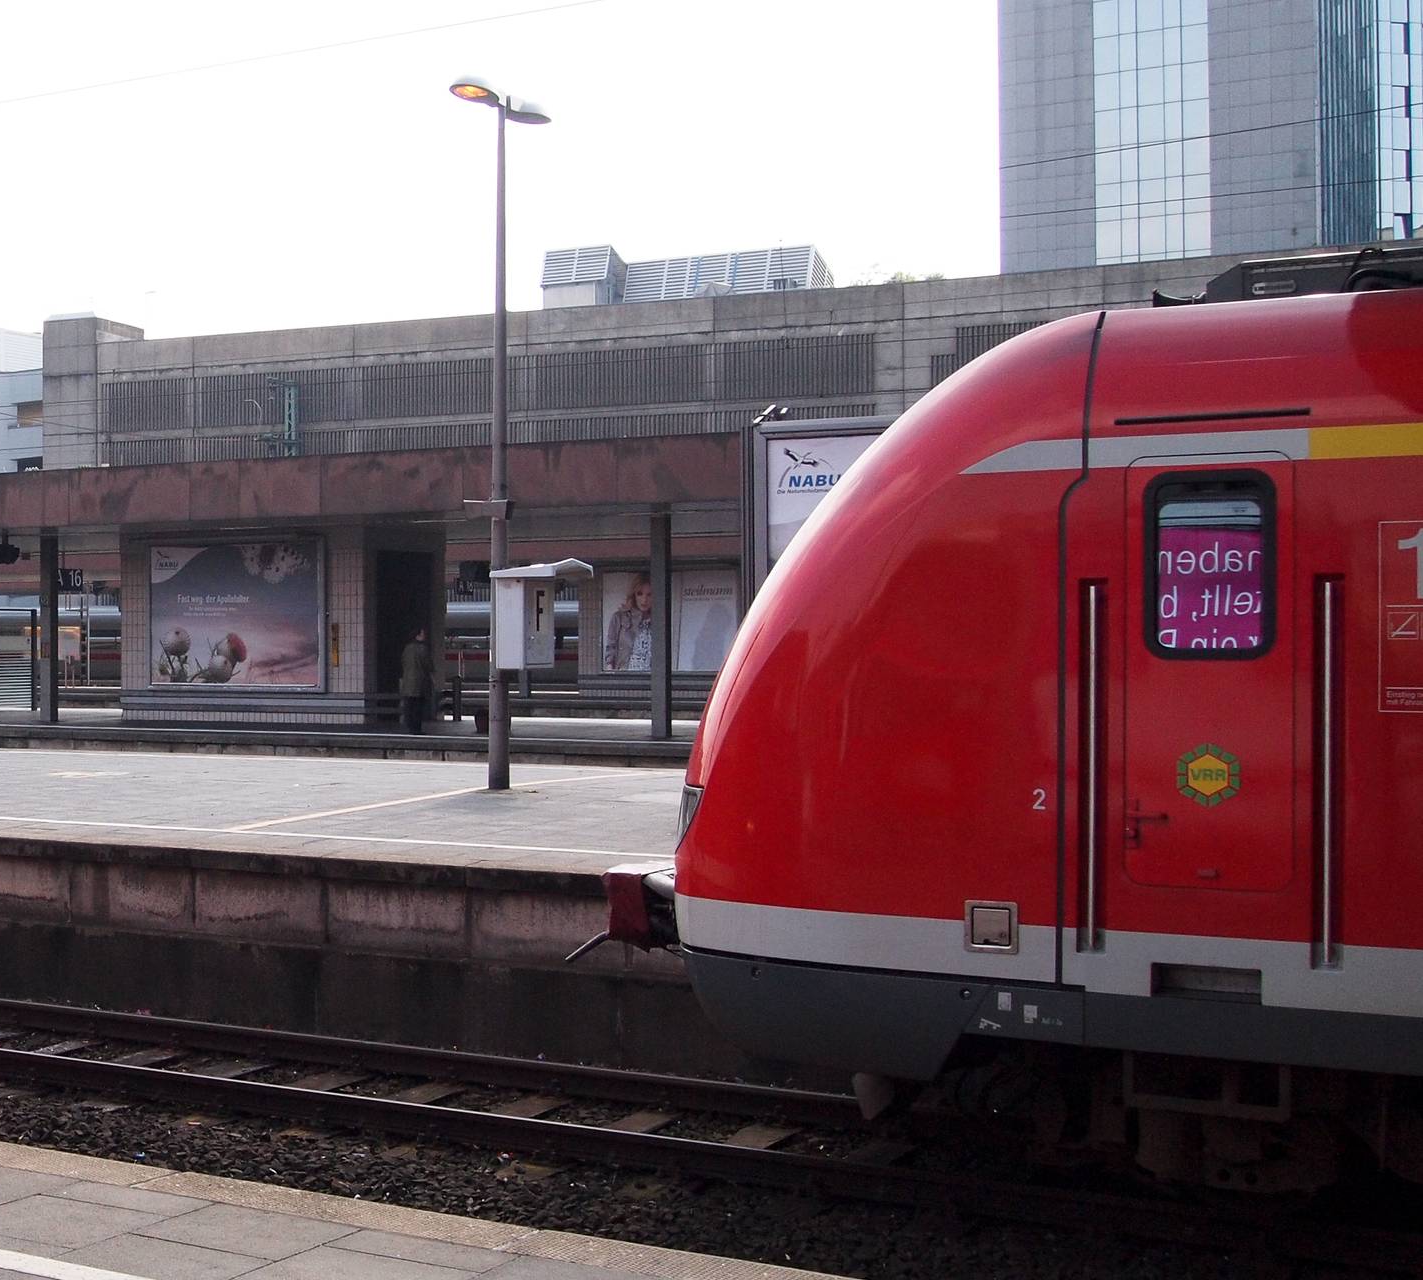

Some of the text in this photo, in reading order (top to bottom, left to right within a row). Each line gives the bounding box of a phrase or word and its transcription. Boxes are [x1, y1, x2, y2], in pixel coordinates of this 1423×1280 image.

[788, 474, 841, 488] NABU
[69, 570, 82, 587] 16
[1190, 767, 1227, 782] VRR
[1032, 788, 1046, 810] 2
